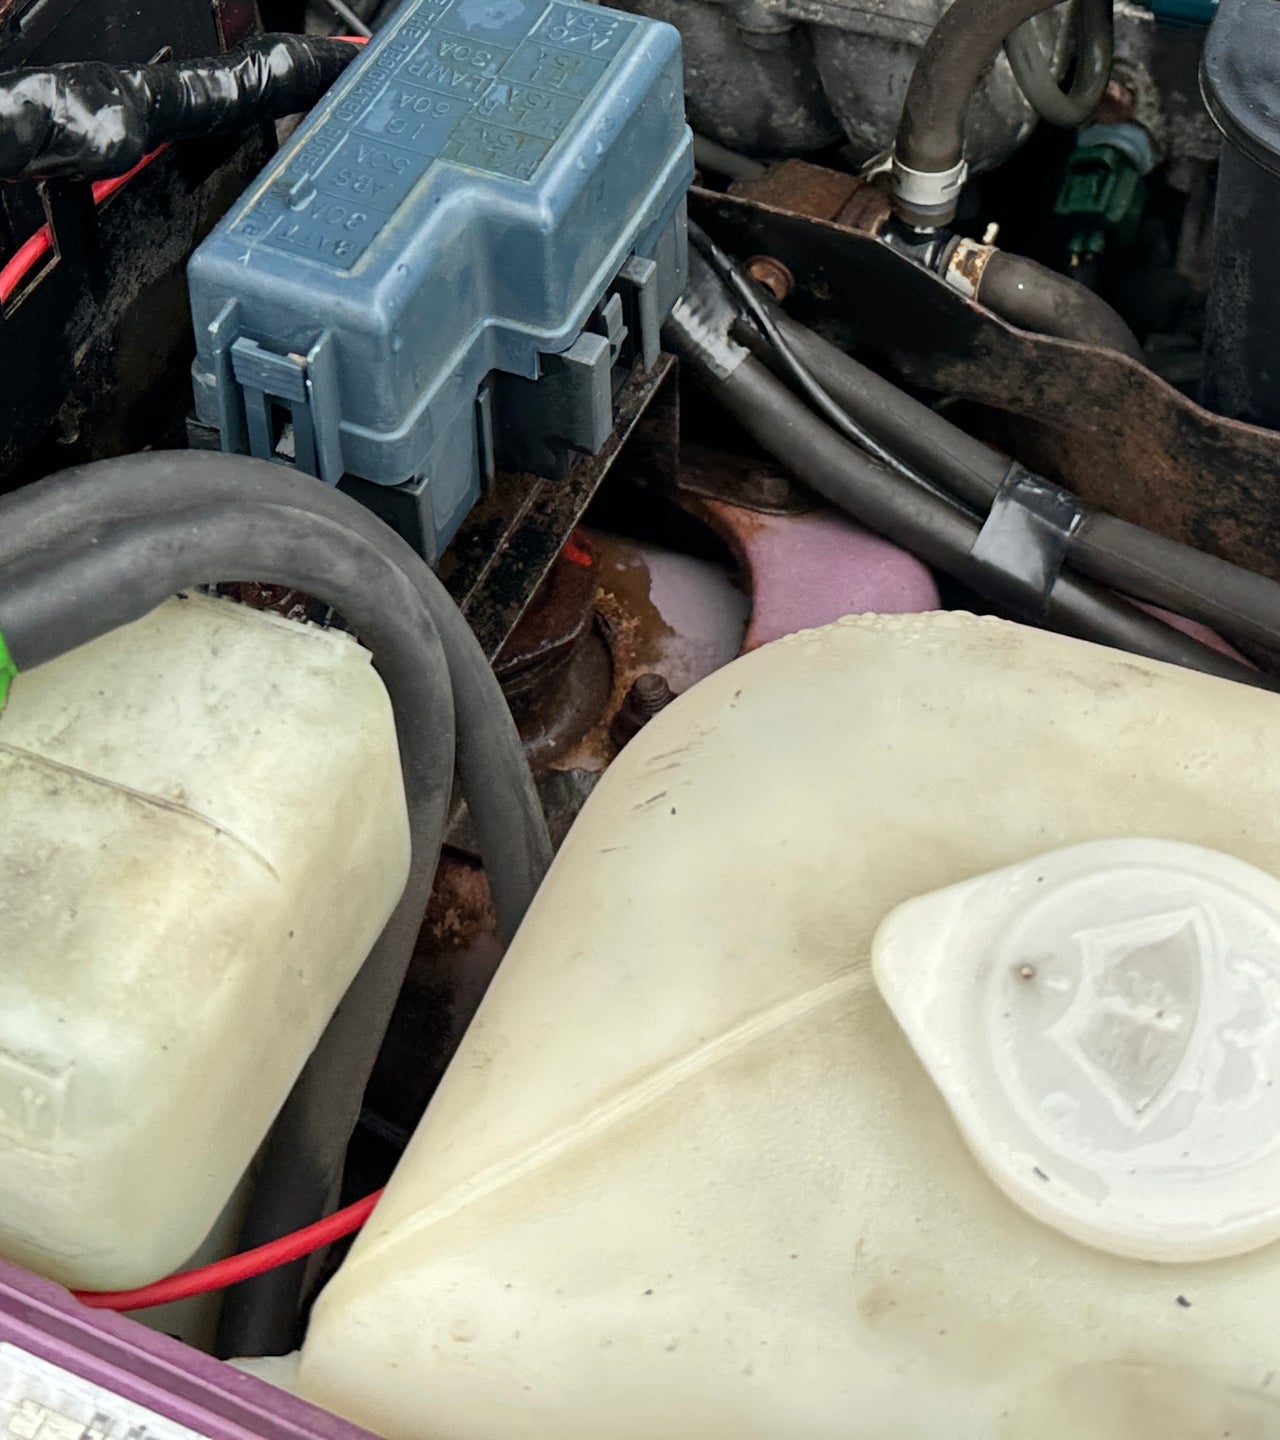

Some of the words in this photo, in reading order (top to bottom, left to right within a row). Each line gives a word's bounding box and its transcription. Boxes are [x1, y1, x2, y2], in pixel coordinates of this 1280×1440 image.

[398, 9, 436, 38] THE
[542, 21, 613, 52] A/C
[430, 38, 496, 66] 30A
[329, 42, 410, 121] DESIGNATED
[401, 56, 489, 93] LAMP
[389, 89, 456, 119] 60A
[286, 125, 341, 175] FUSES
[345, 143, 415, 175] 50A
[326, 168, 392, 198] ABS
